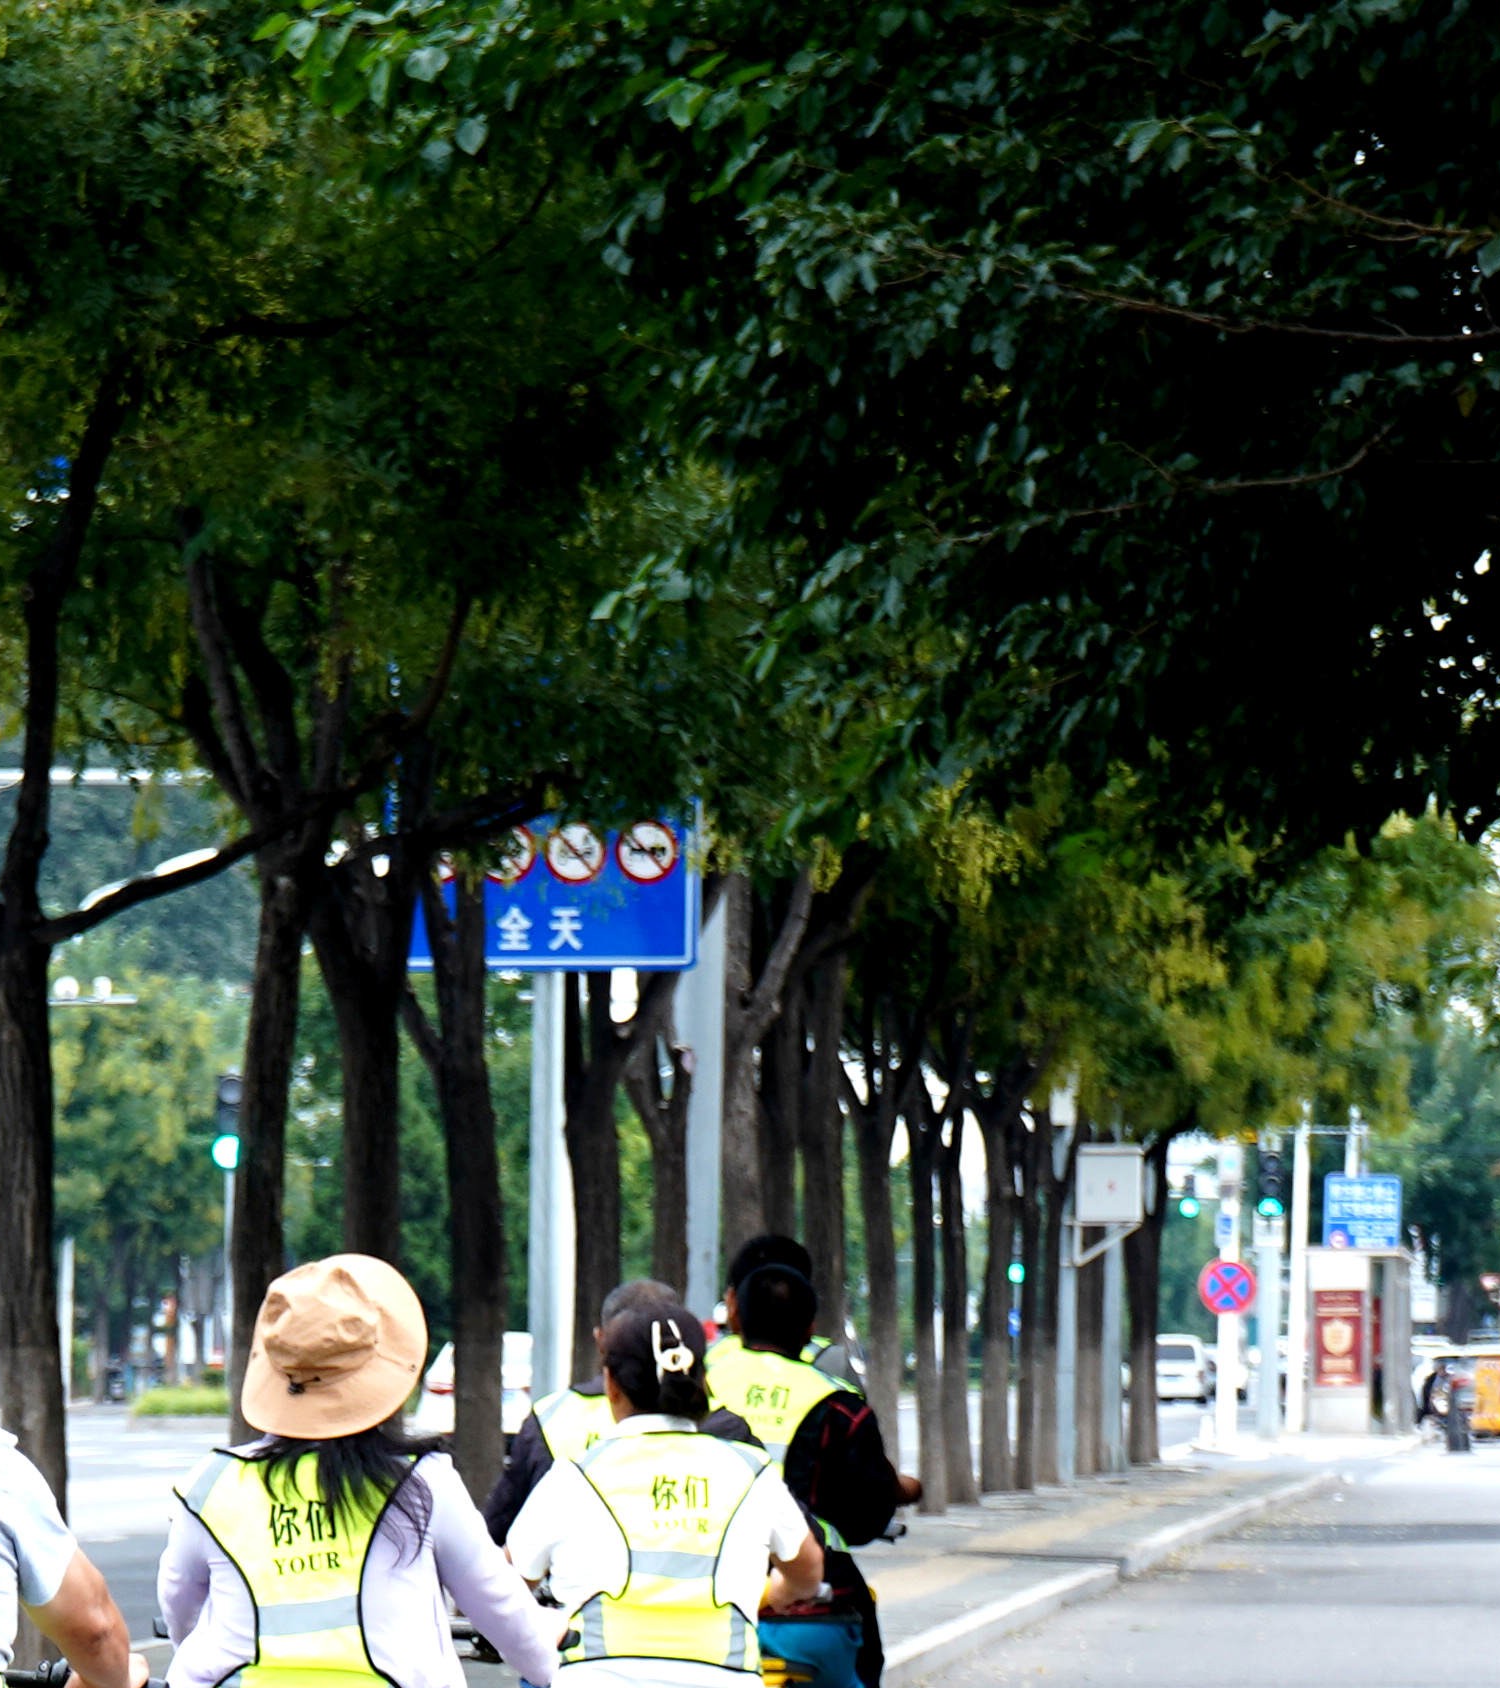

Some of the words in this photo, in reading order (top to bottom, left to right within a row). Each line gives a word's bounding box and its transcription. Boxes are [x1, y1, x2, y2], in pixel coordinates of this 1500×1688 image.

[496, 904, 584, 951] 全天
[651, 1475, 709, 1510] 你们
[269, 1500, 337, 1547] 你们
[273, 1551, 341, 1575] YOUR
